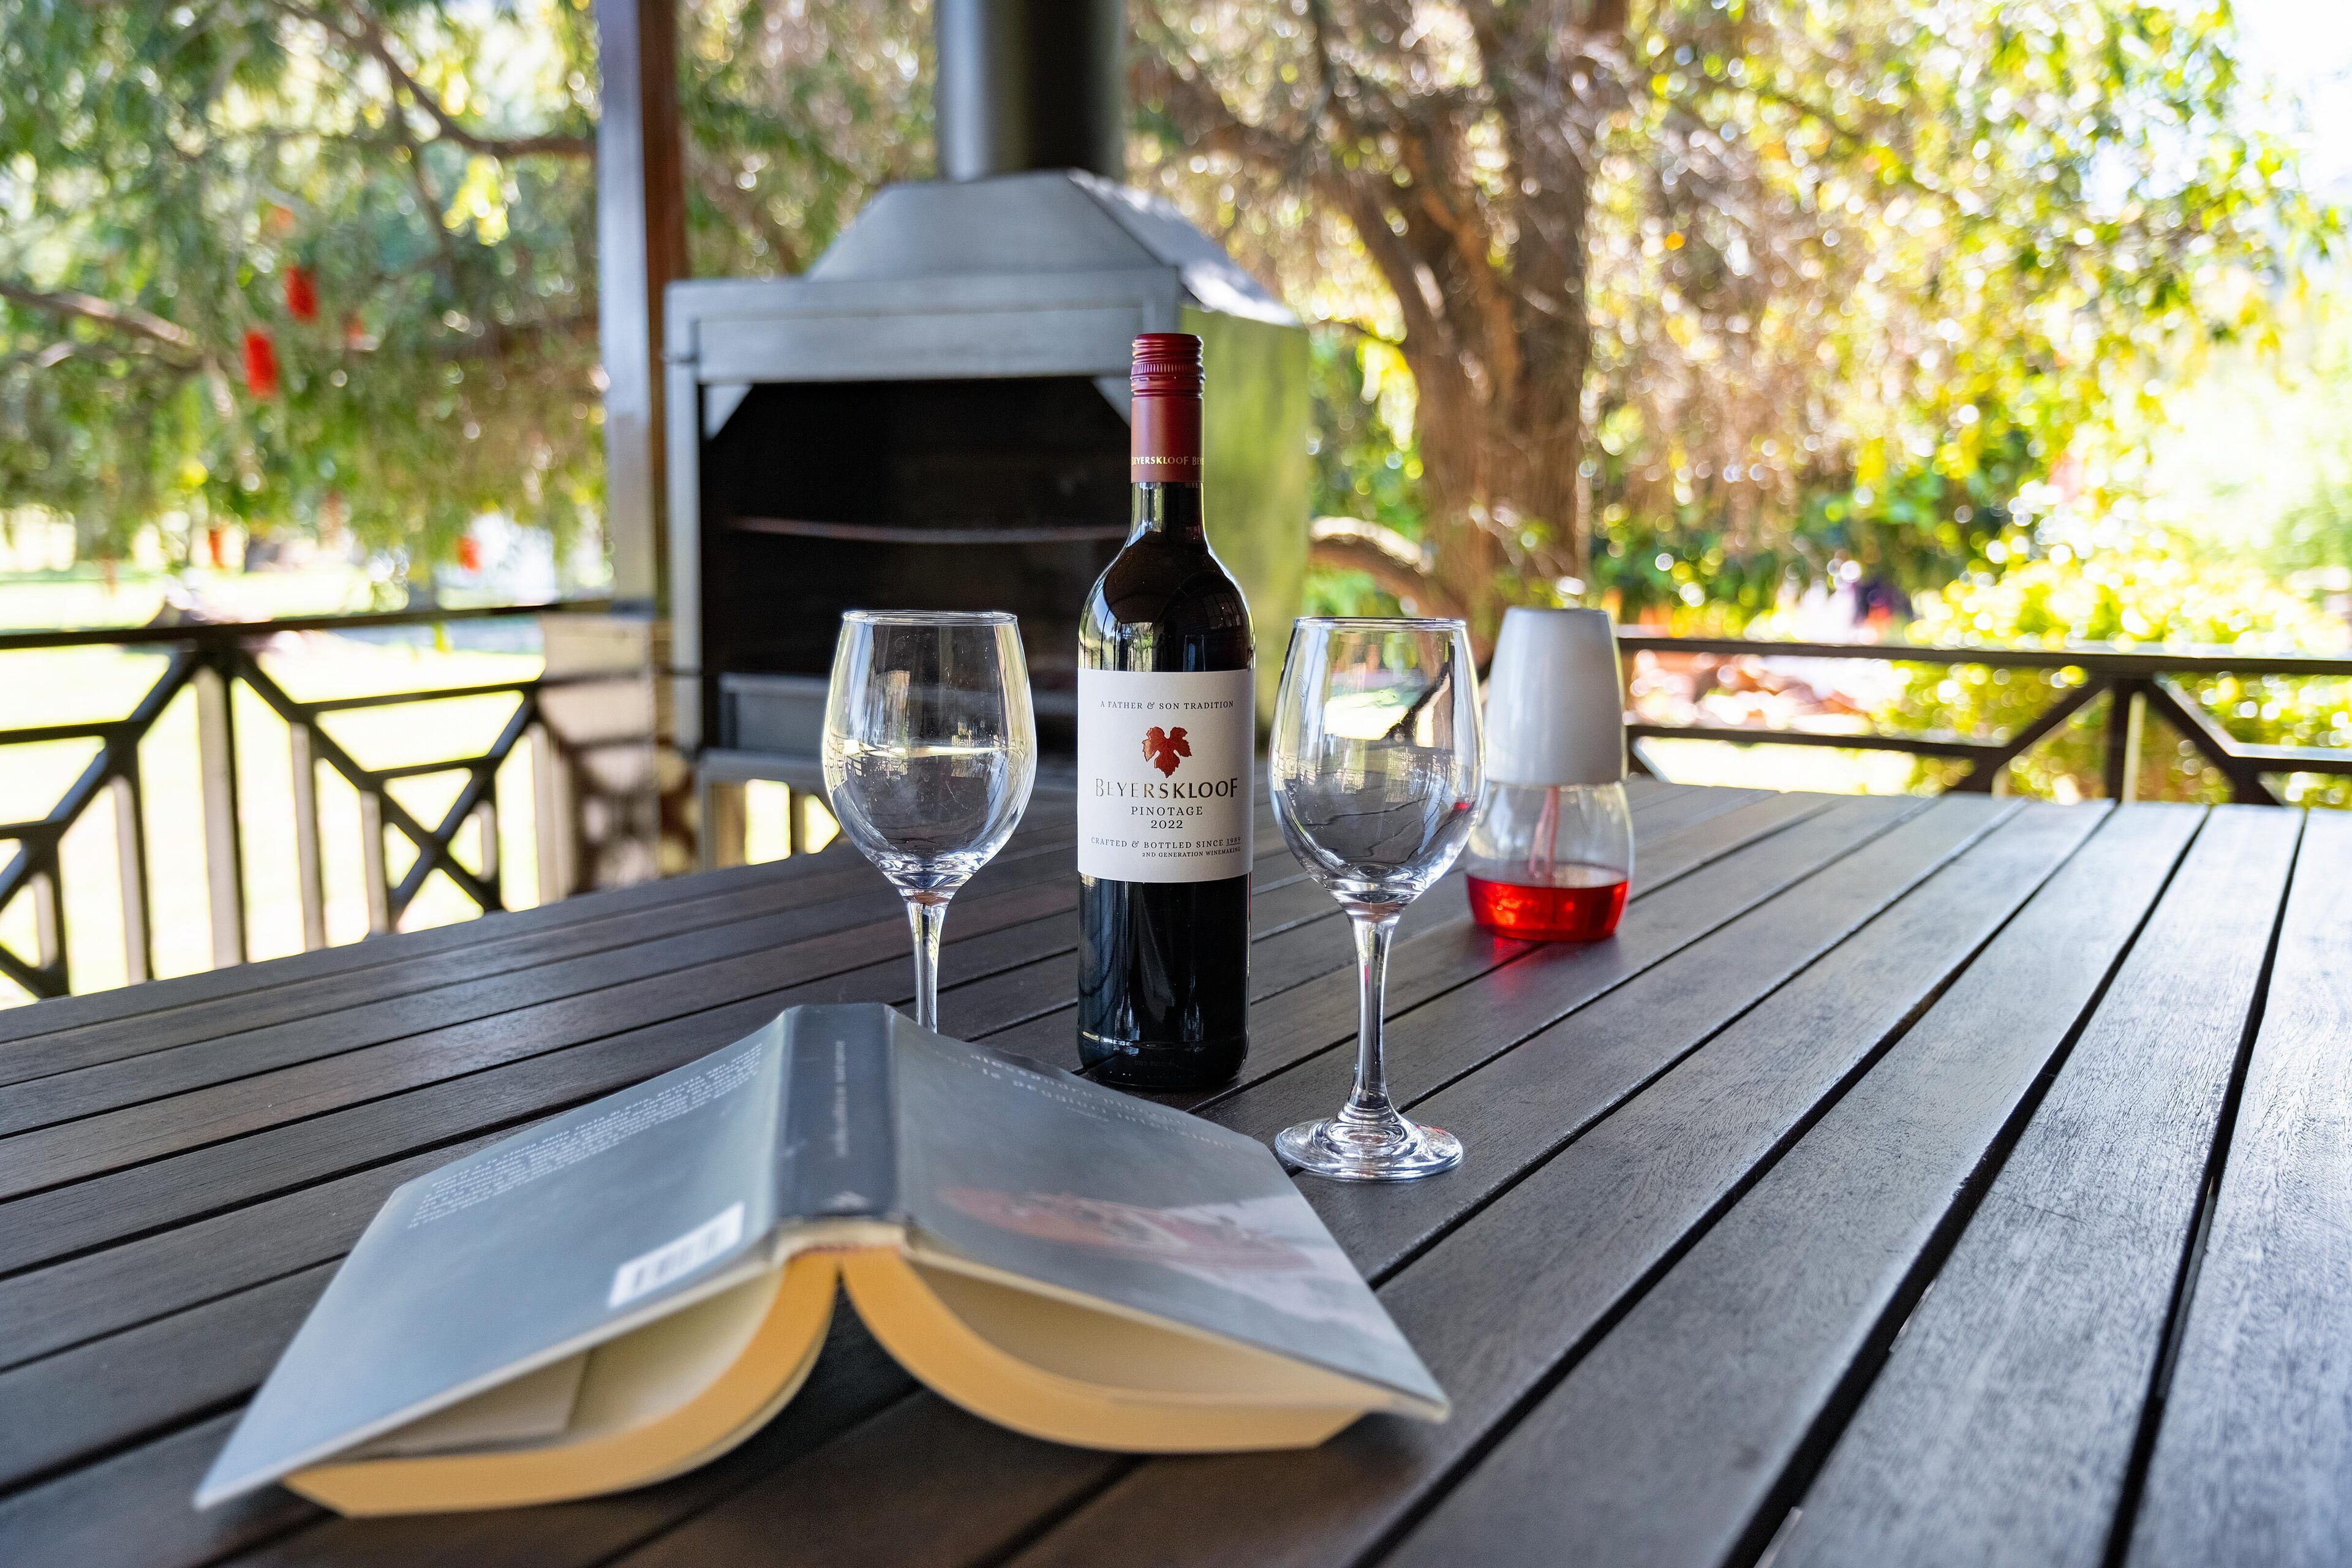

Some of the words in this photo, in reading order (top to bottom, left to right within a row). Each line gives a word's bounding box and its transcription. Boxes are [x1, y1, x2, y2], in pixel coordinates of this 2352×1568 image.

[1131, 456, 1188, 466] BEYERSKLOOF
[1184, 701, 1234, 709] TRADITION
[1096, 778, 1238, 799] BEYERSKLOOF
[1131, 806, 1203, 816] PINOTAGE
[1151, 820, 1183, 829] 2022
[1091, 837, 1127, 847] CRAFTED
[1196, 839, 1224, 848] SINCE
[1205, 847, 1240, 856] WINEMAKING
